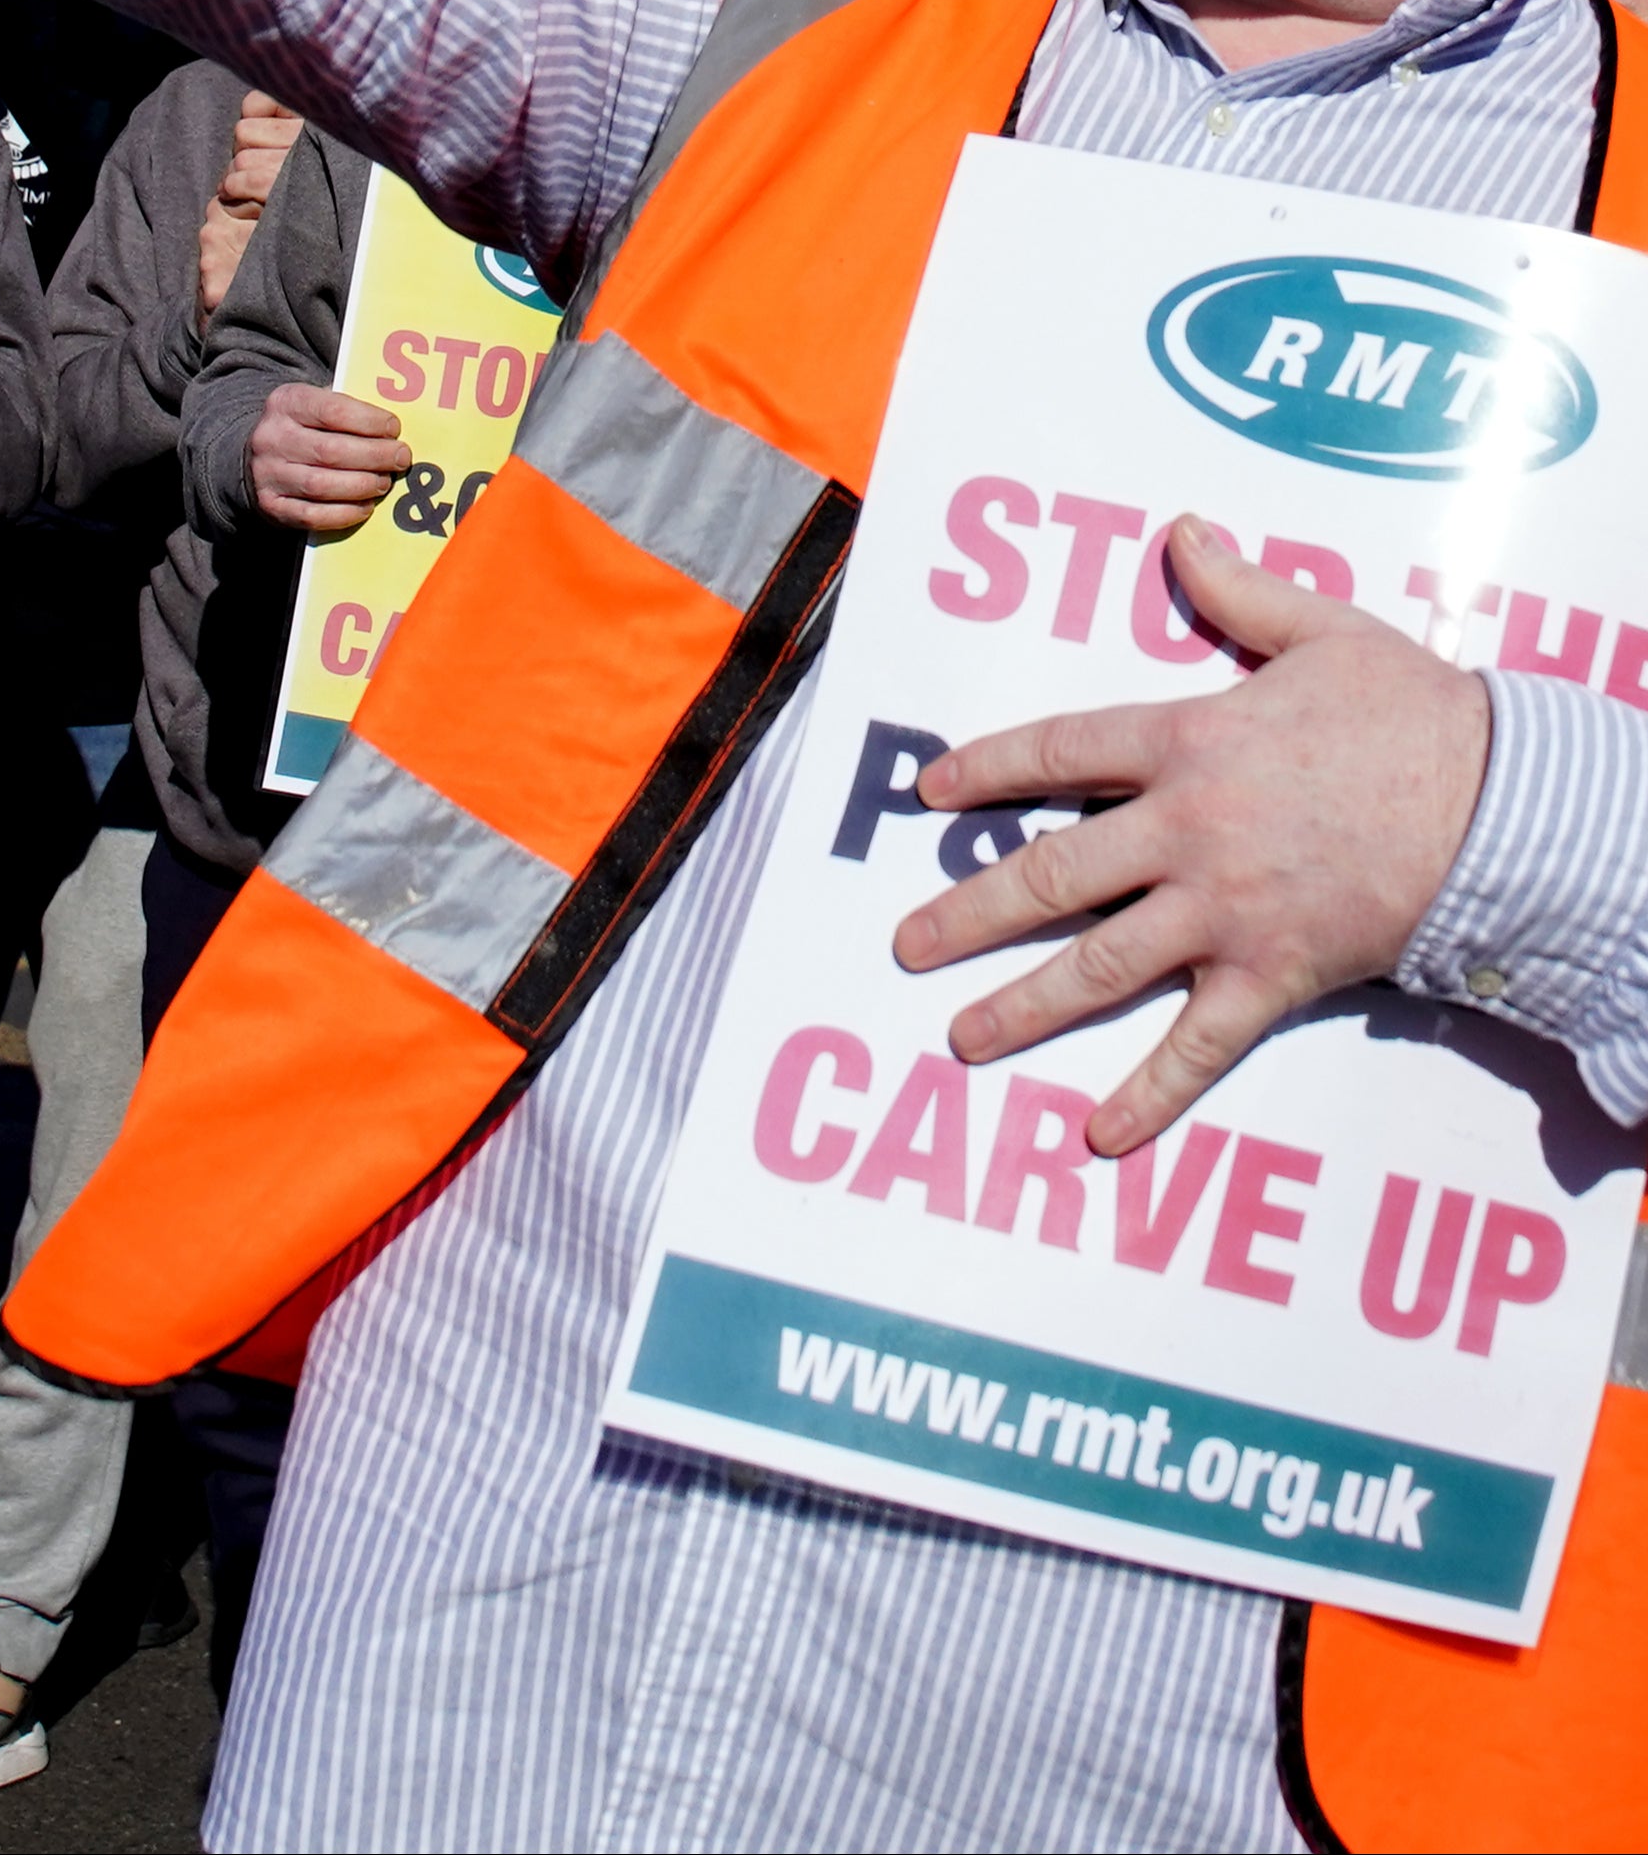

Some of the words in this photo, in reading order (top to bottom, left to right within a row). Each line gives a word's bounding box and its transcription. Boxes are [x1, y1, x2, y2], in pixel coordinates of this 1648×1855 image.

[1242, 315, 1506, 424] RMT
[830, 719, 1102, 884] P&
[753, 1024, 1322, 1307] CARVE
[1357, 1171, 1567, 1359] UP
[777, 1327, 1436, 1550] www.rmt.org.uk
